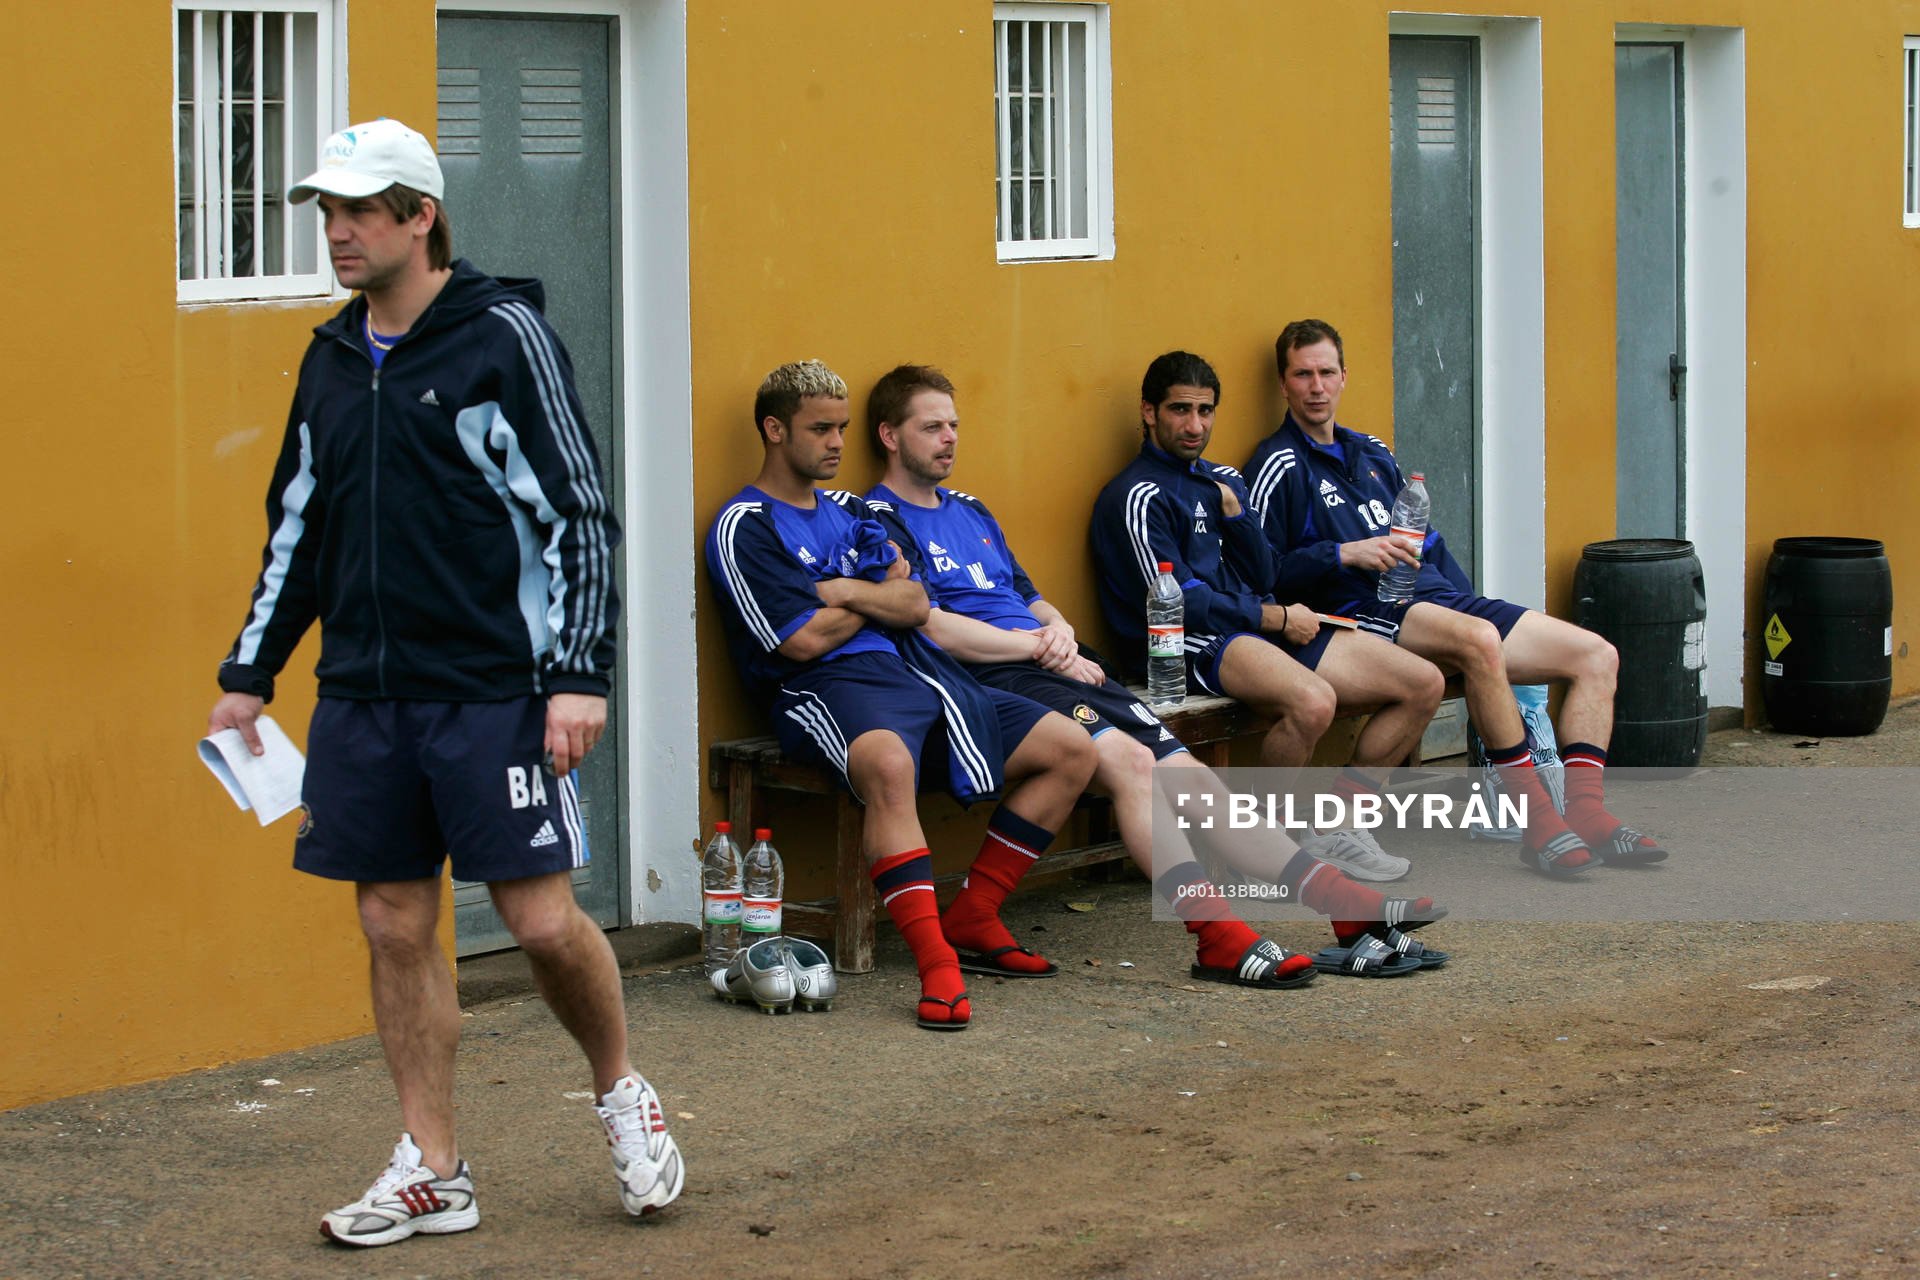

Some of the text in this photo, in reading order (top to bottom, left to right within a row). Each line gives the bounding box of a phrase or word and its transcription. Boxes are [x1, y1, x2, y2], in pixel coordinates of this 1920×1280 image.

[1323, 494, 1346, 508] ICA
[1357, 499, 1392, 531] 18
[932, 555, 961, 573] ICA
[507, 764, 549, 810] BA
[530, 834, 560, 848] adidas
